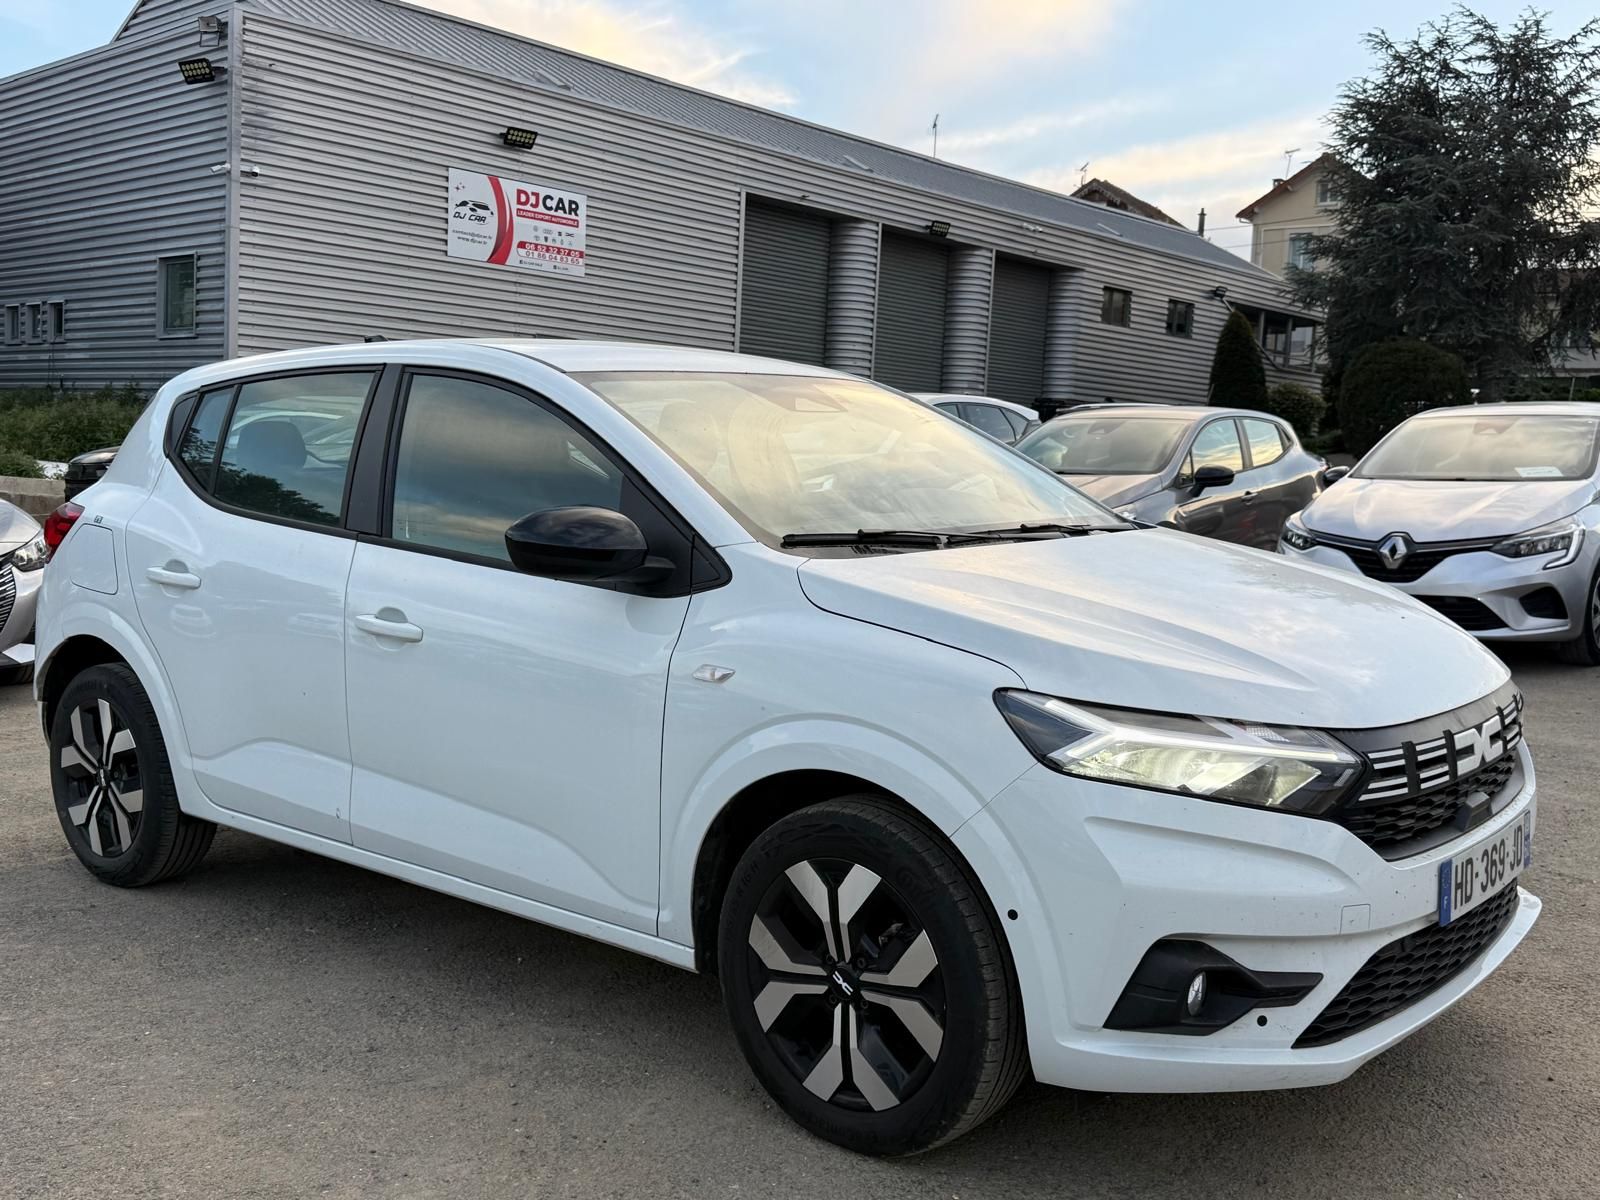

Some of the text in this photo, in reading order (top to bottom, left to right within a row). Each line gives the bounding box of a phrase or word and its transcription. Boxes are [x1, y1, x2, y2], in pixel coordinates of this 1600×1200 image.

[453, 211, 487, 224] DJ CAR
[517, 210, 535, 218] LEADER
[535, 213, 552, 221] EXPORT
